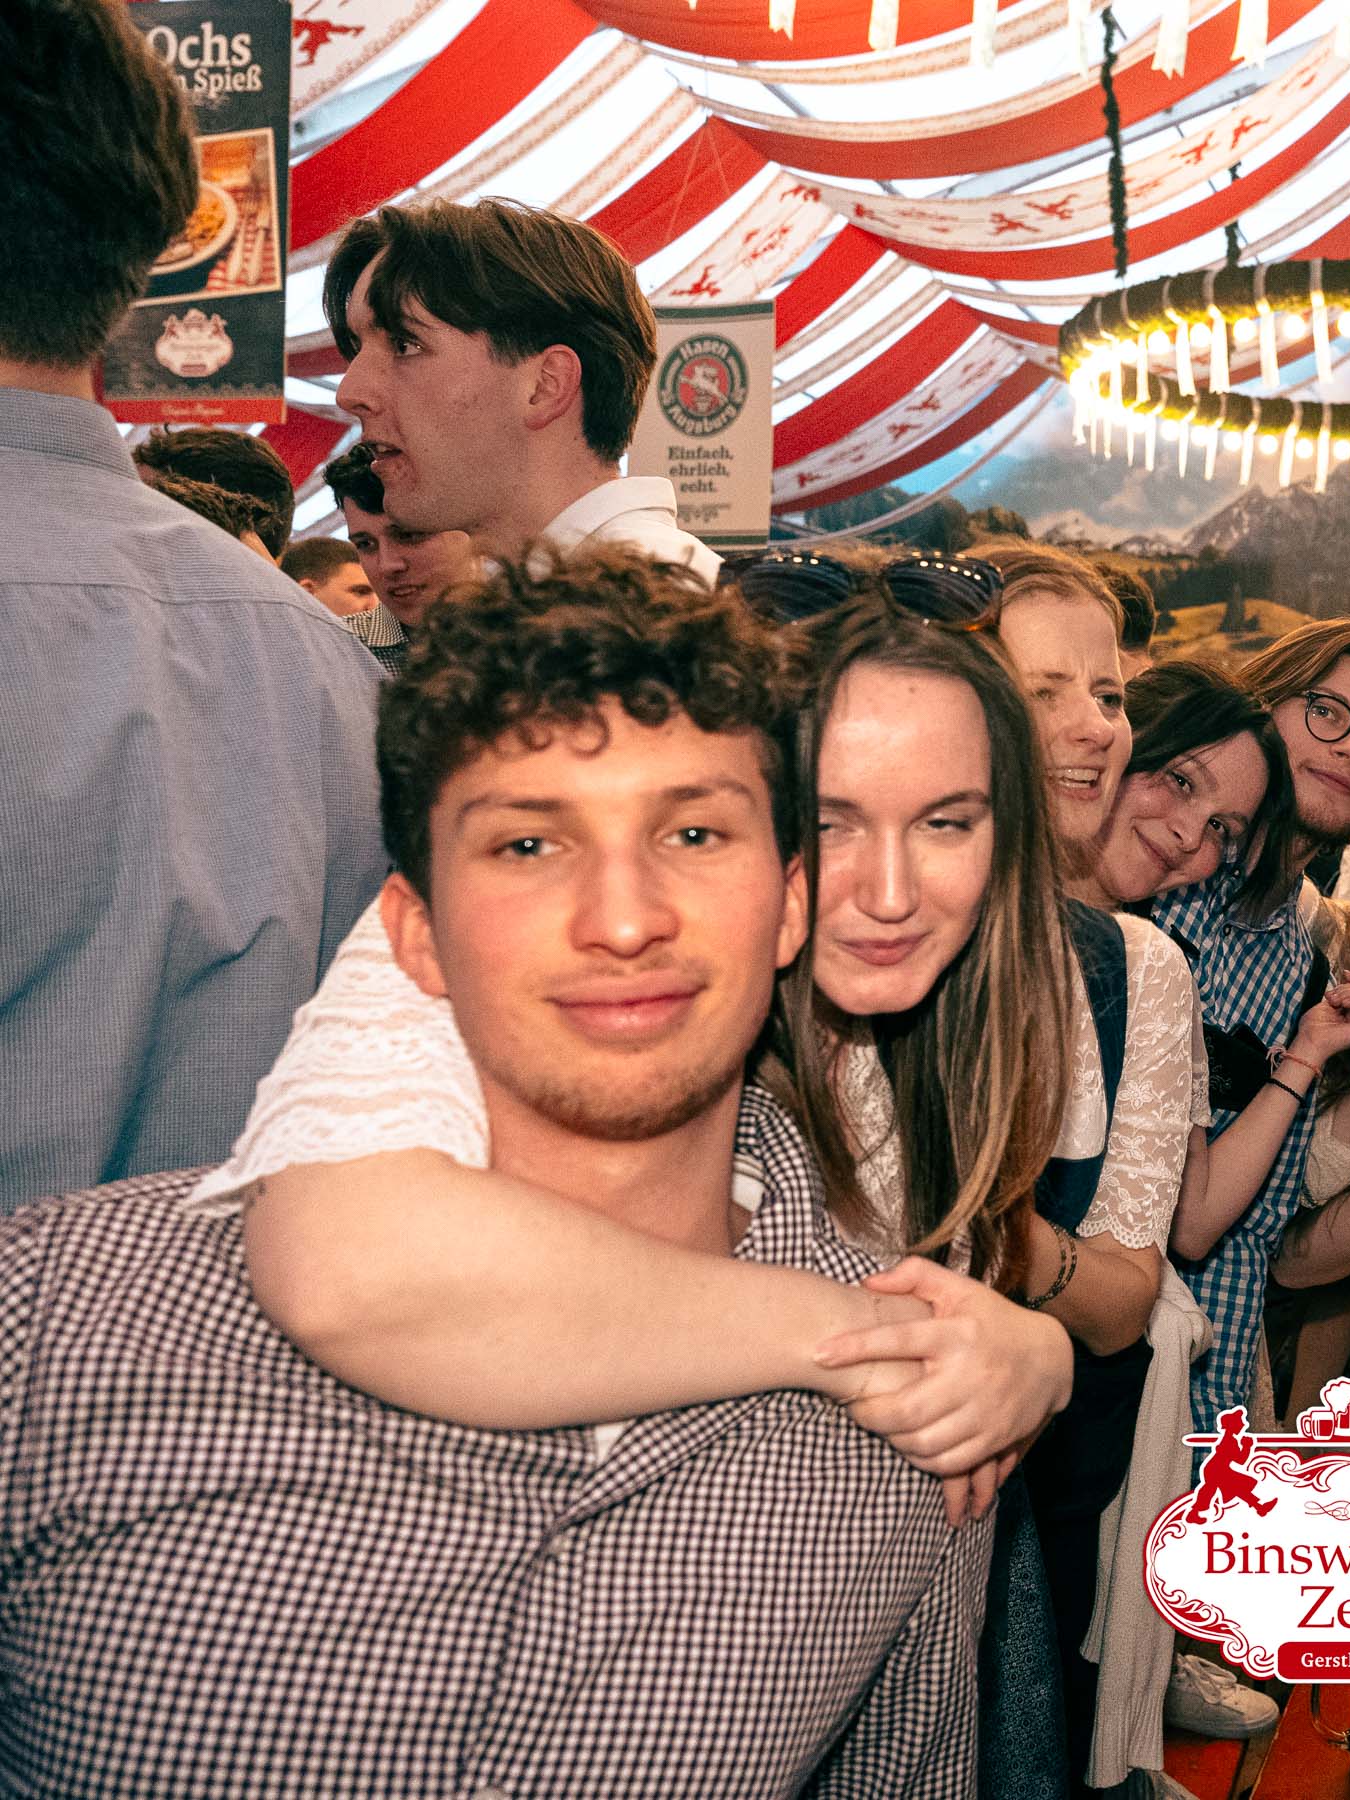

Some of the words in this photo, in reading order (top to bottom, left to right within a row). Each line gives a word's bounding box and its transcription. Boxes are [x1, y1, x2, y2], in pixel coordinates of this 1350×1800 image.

[146, 21, 253, 69] Ochs
[193, 64, 263, 99] Spieß
[668, 444, 734, 461] Einfach,
[669, 462, 730, 478] ehrlich,
